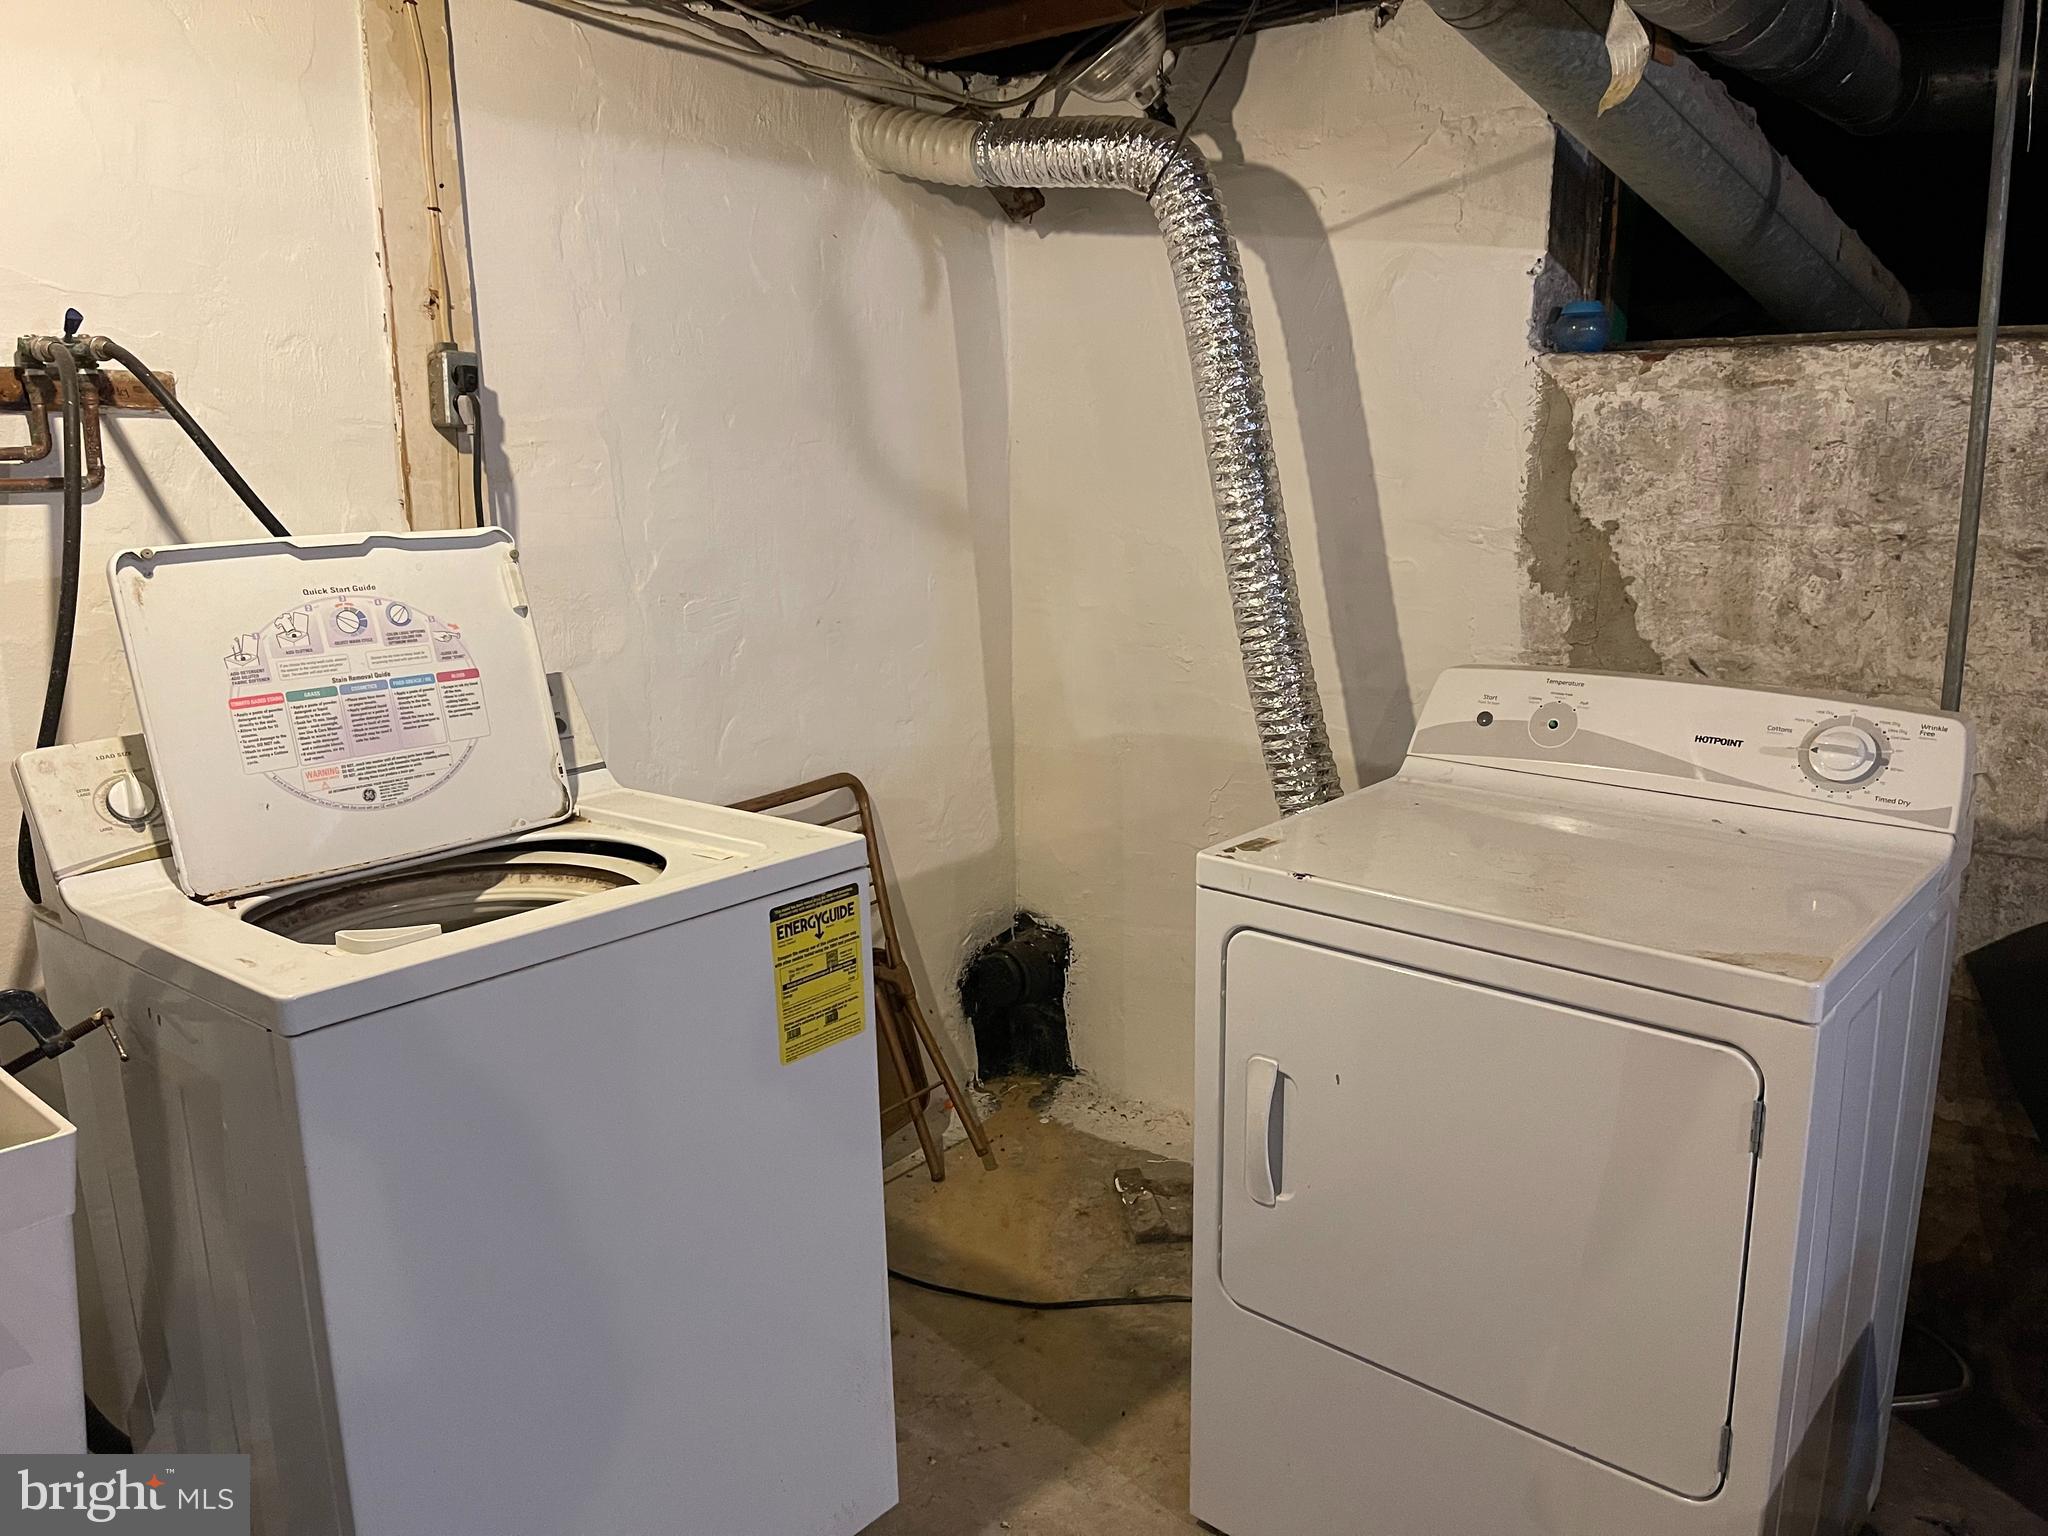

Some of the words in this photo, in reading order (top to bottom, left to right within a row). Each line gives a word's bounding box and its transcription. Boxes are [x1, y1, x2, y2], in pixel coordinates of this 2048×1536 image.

[303, 588, 328, 596] Quick
[1546, 678, 1584, 687] Temperature
[1767, 725, 1792, 733] Cottons
[1921, 723, 1948, 732] Wrinkle
[1695, 735, 1744, 747] HOTPOINT
[305, 767, 339, 779] WARNING
[1875, 795, 1896, 804] Timed
[1898, 798, 1911, 807] Dry
[776, 902, 854, 940] ENERGYGUIDE
